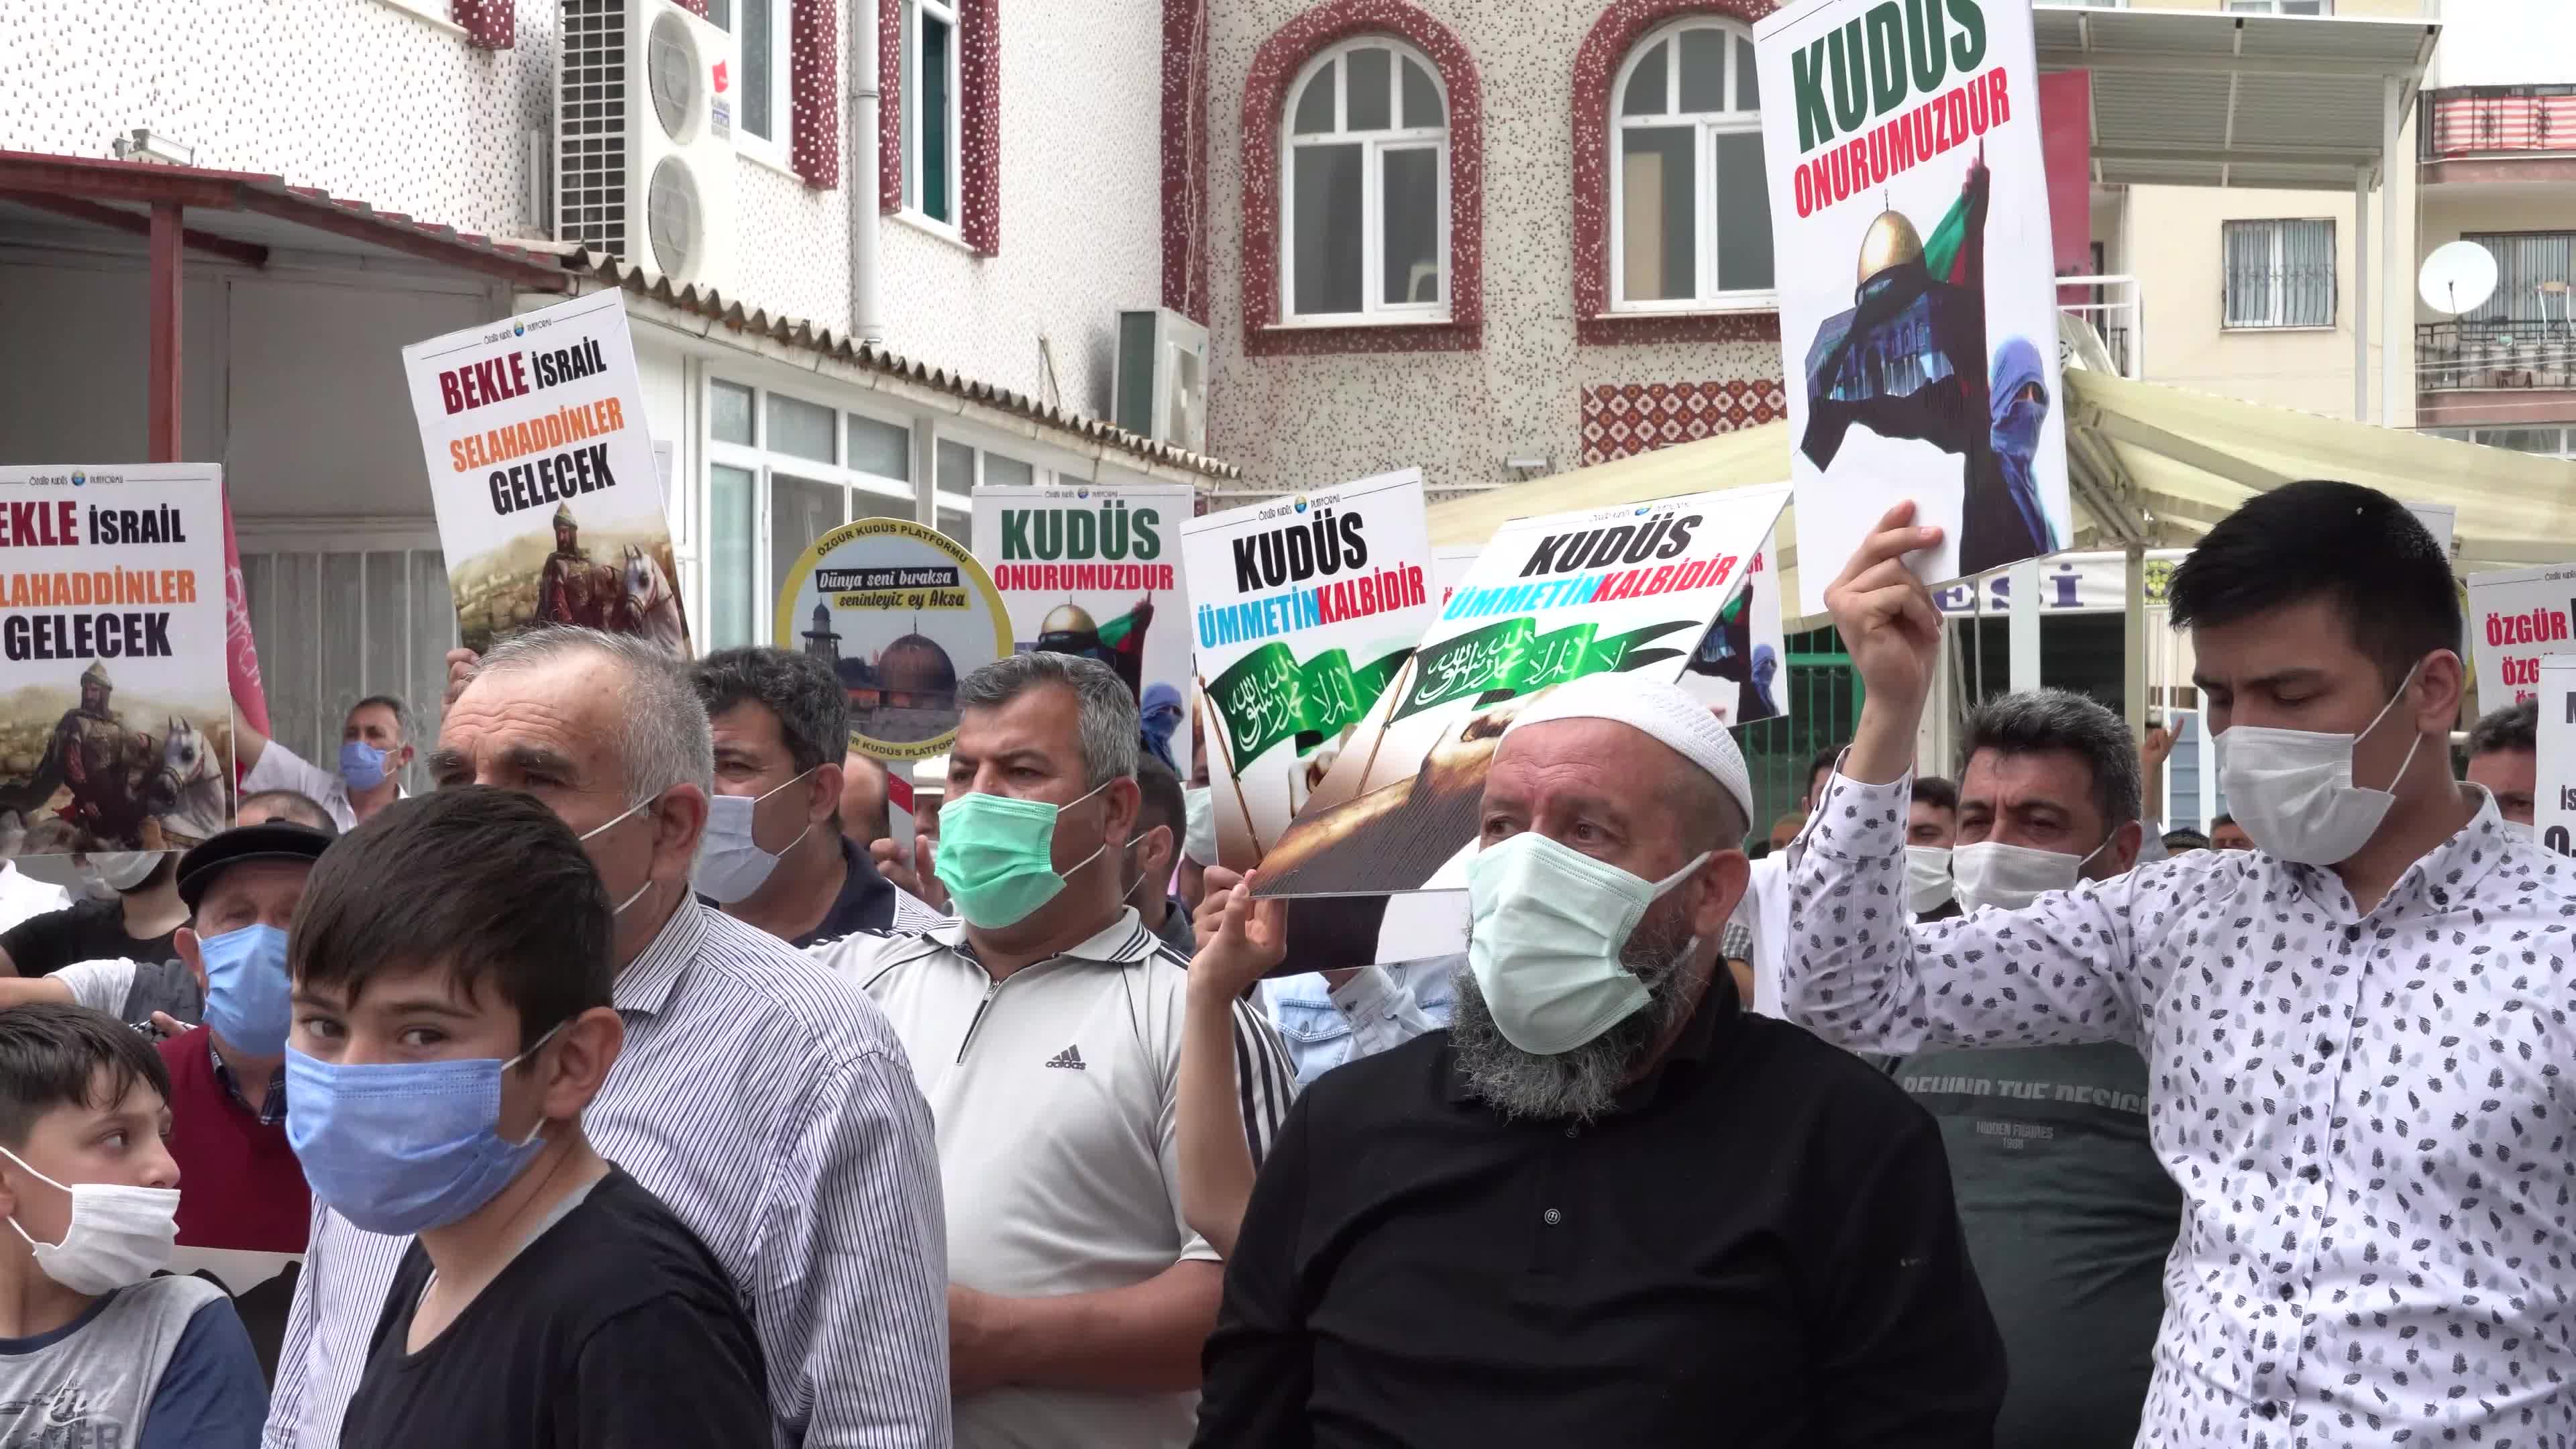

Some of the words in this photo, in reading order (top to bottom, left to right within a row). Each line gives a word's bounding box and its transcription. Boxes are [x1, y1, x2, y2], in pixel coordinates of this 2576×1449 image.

[1794, 66, 2011, 219] ONURUMUZDUR
[439, 352, 530, 415] BEKLE
[531, 336, 607, 390] İSRAİL
[450, 396, 625, 473] SELAHADDİNLER
[489, 443, 616, 516] GELECEK
[89, 503, 186, 545] İSRAİL
[900, 525, 969, 564] PLATFORMU
[1001, 499, 1161, 561] KUDÜS
[1519, 513, 1704, 578] KUDÜS
[1232, 507, 1368, 593] KUDÜS
[820, 572, 863, 591] Dünya
[867, 571, 895, 587] seni
[908, 596, 925, 610] ey
[928, 590, 965, 607] Aksa
[994, 564, 1174, 591] ONURUMUZDUR
[4, 612, 172, 661] GELECEK
[2485, 607, 2568, 647] ÖZGÜR
[905, 736, 955, 757] PLATFOR
